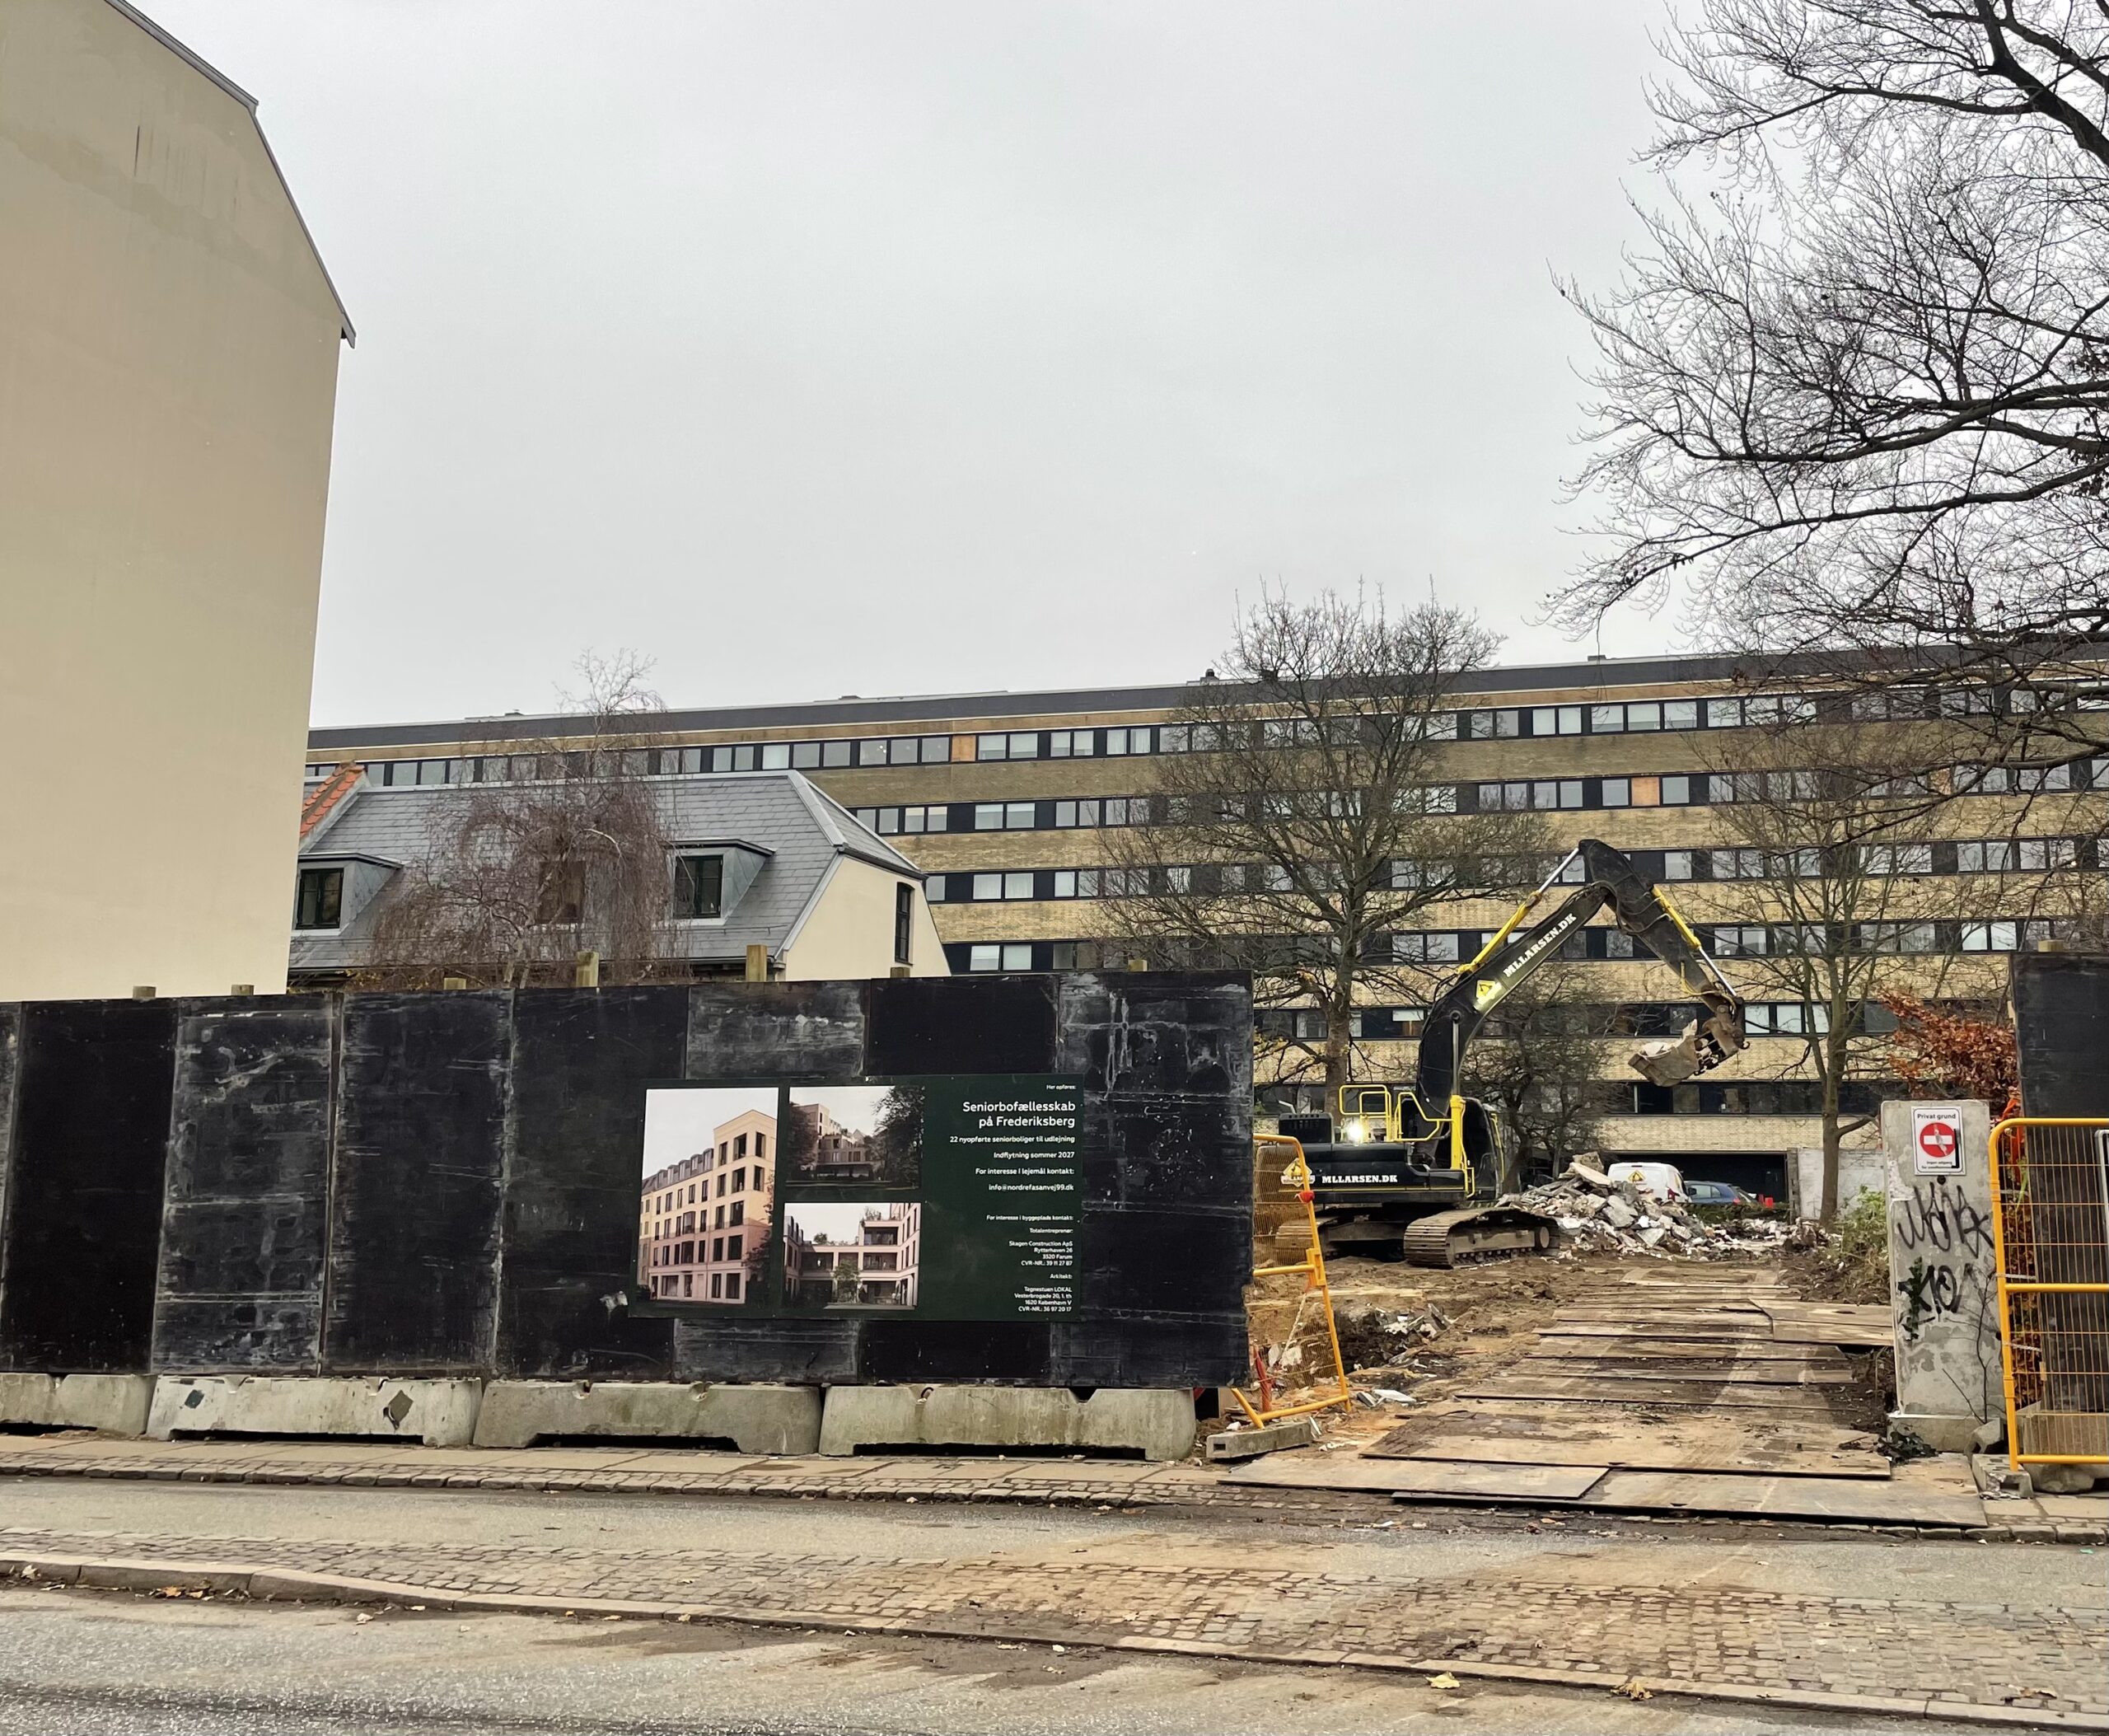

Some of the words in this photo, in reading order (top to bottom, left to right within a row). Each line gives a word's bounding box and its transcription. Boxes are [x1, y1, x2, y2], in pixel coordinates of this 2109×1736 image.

[1503, 913, 1577, 978] MLLARSEN.DK
[962, 1101, 1076, 1112] Seniorbofællesskab
[979, 1116, 994, 1129] på
[996, 1116, 1075, 1129] Frederiksberg
[959, 1136, 991, 1144] nyopførte
[992, 1135, 1035, 1144] seniorboliger
[1045, 1135, 1075, 1144] udlejning
[994, 1152, 1030, 1160] Indflytning
[1022, 1167, 1046, 1176] lejemål
[1321, 1174, 1398, 1184] MLLARSEN.DK
